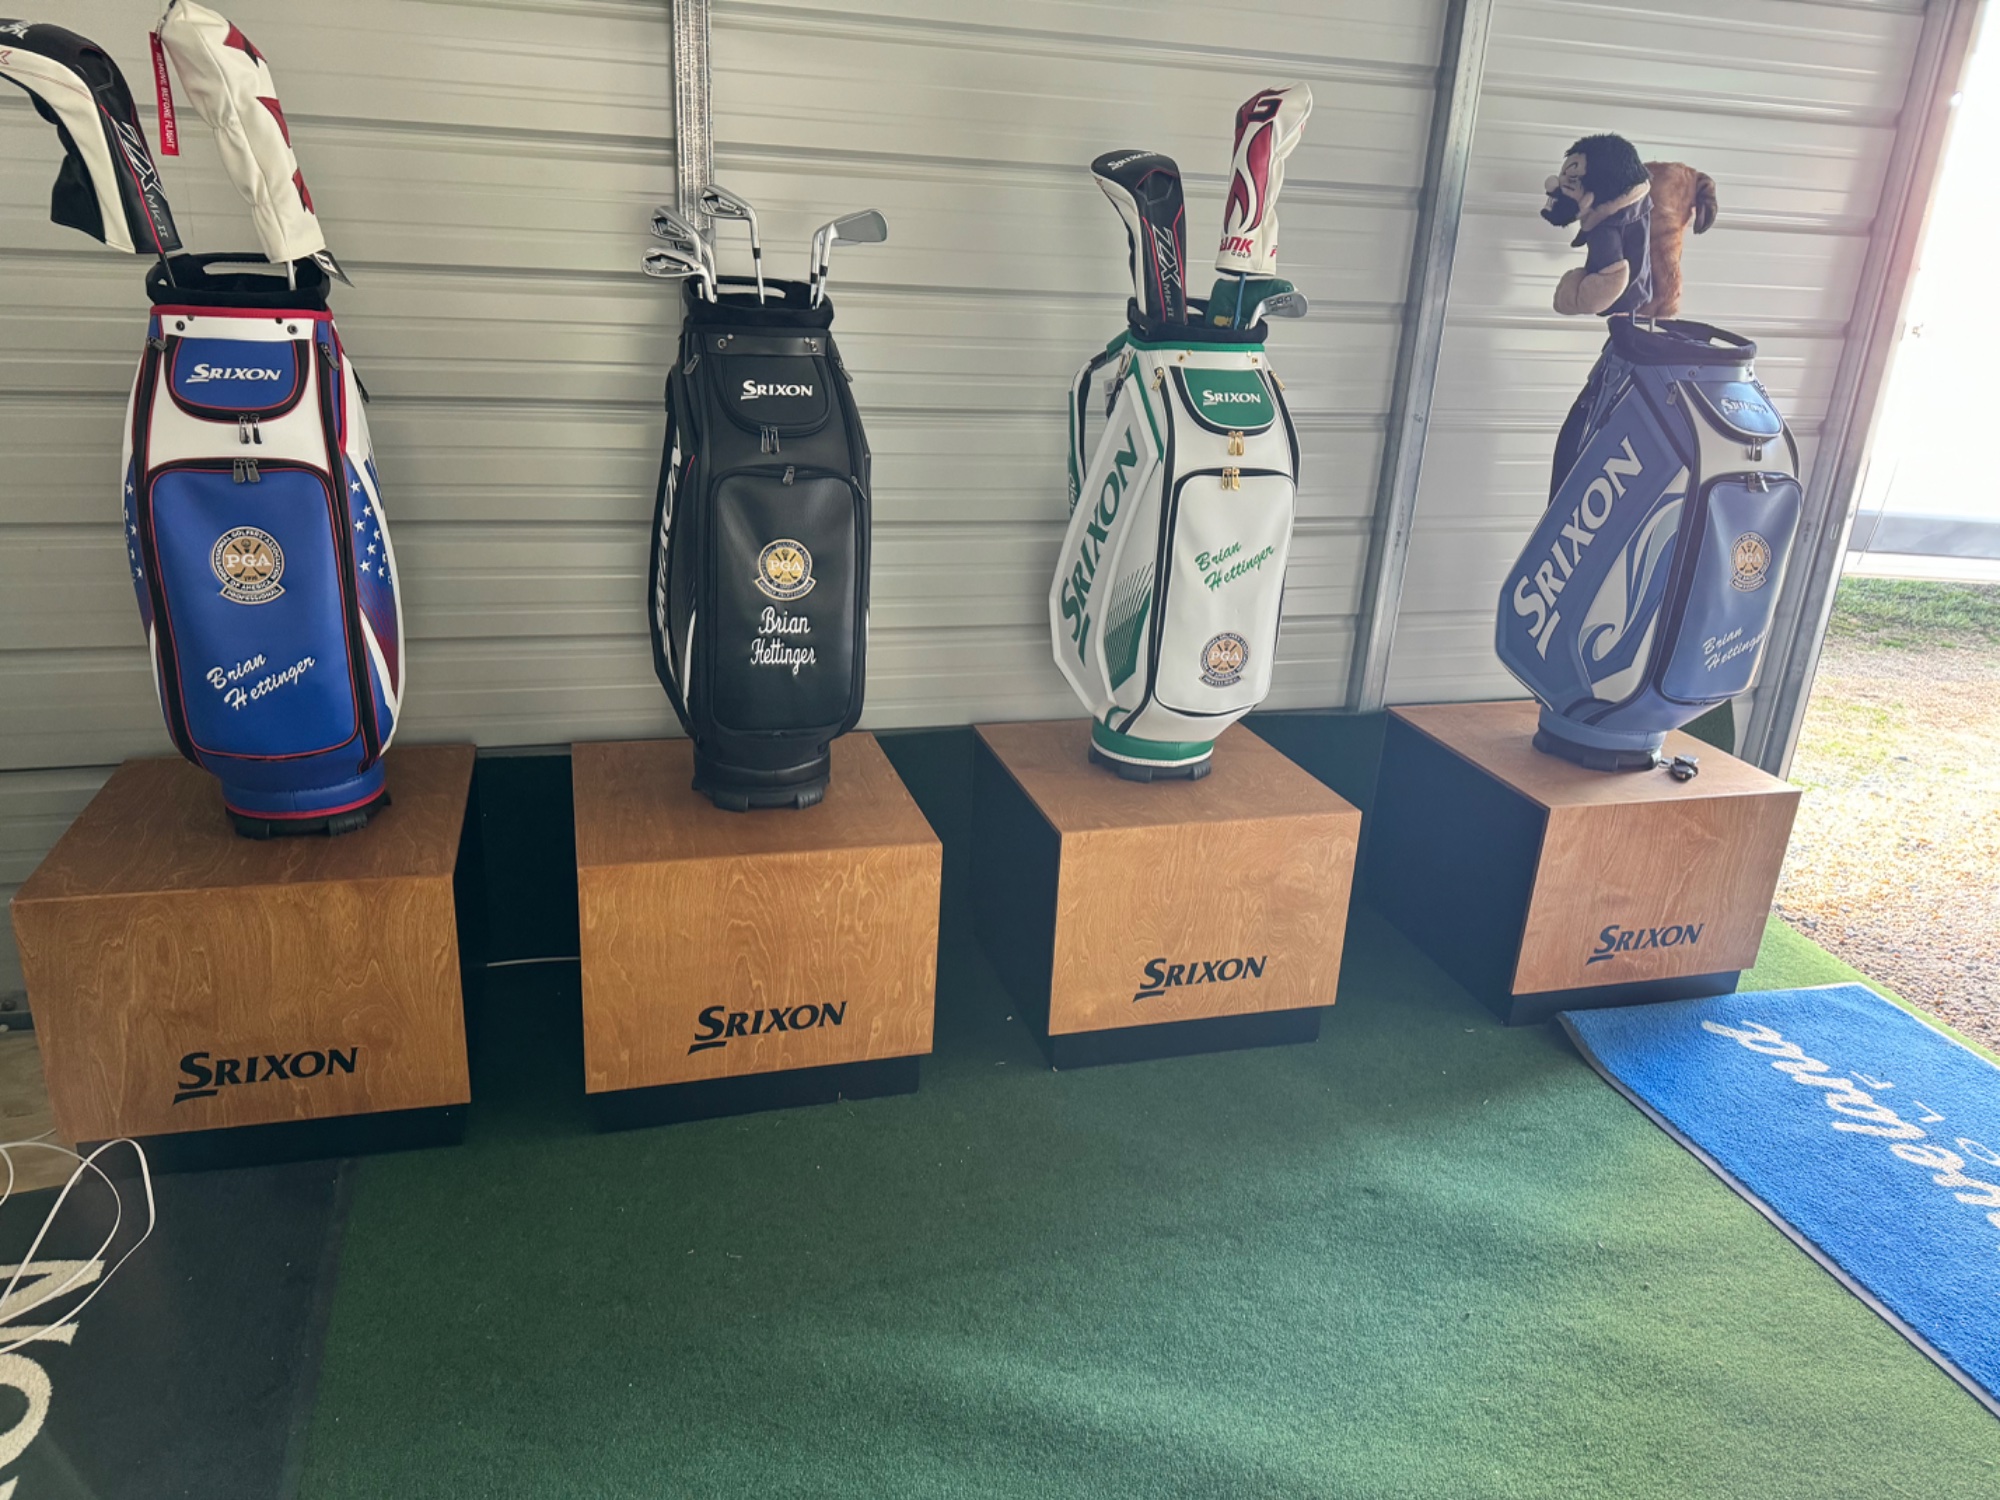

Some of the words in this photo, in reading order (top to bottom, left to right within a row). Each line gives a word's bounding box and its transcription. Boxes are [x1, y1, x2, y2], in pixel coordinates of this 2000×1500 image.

[161, 87, 173, 119] BEFORE
[165, 120, 176, 149] FLIGHT
[186, 364, 282, 383] SRIXON
[740, 380, 813, 400] SRIXON
[1202, 389, 1262, 406] SRIXON
[225, 553, 272, 568] PGA
[1061, 424, 1139, 668] SRIXON
[1194, 541, 1242, 571] Brian
[1513, 436, 1644, 661] SRIXON
[1738, 552, 1761, 563] PGA
[769, 560, 802, 572] PGA
[1204, 545, 1274, 592] Hettinger
[759, 605, 811, 634] Brian
[750, 637, 817, 676] Hettinger
[1211, 651, 1241, 661] PGA
[1702, 626, 1743, 655] Brian
[206, 653, 266, 689] Brian
[224, 656, 315, 710] Hettinger
[1586, 924, 1705, 965] SRIXON
[1133, 955, 1268, 1003] SRIXON
[687, 1001, 848, 1056] SRIXON
[173, 1047, 359, 1105] SRIXON
[1702, 1019, 2000, 1229] veland
